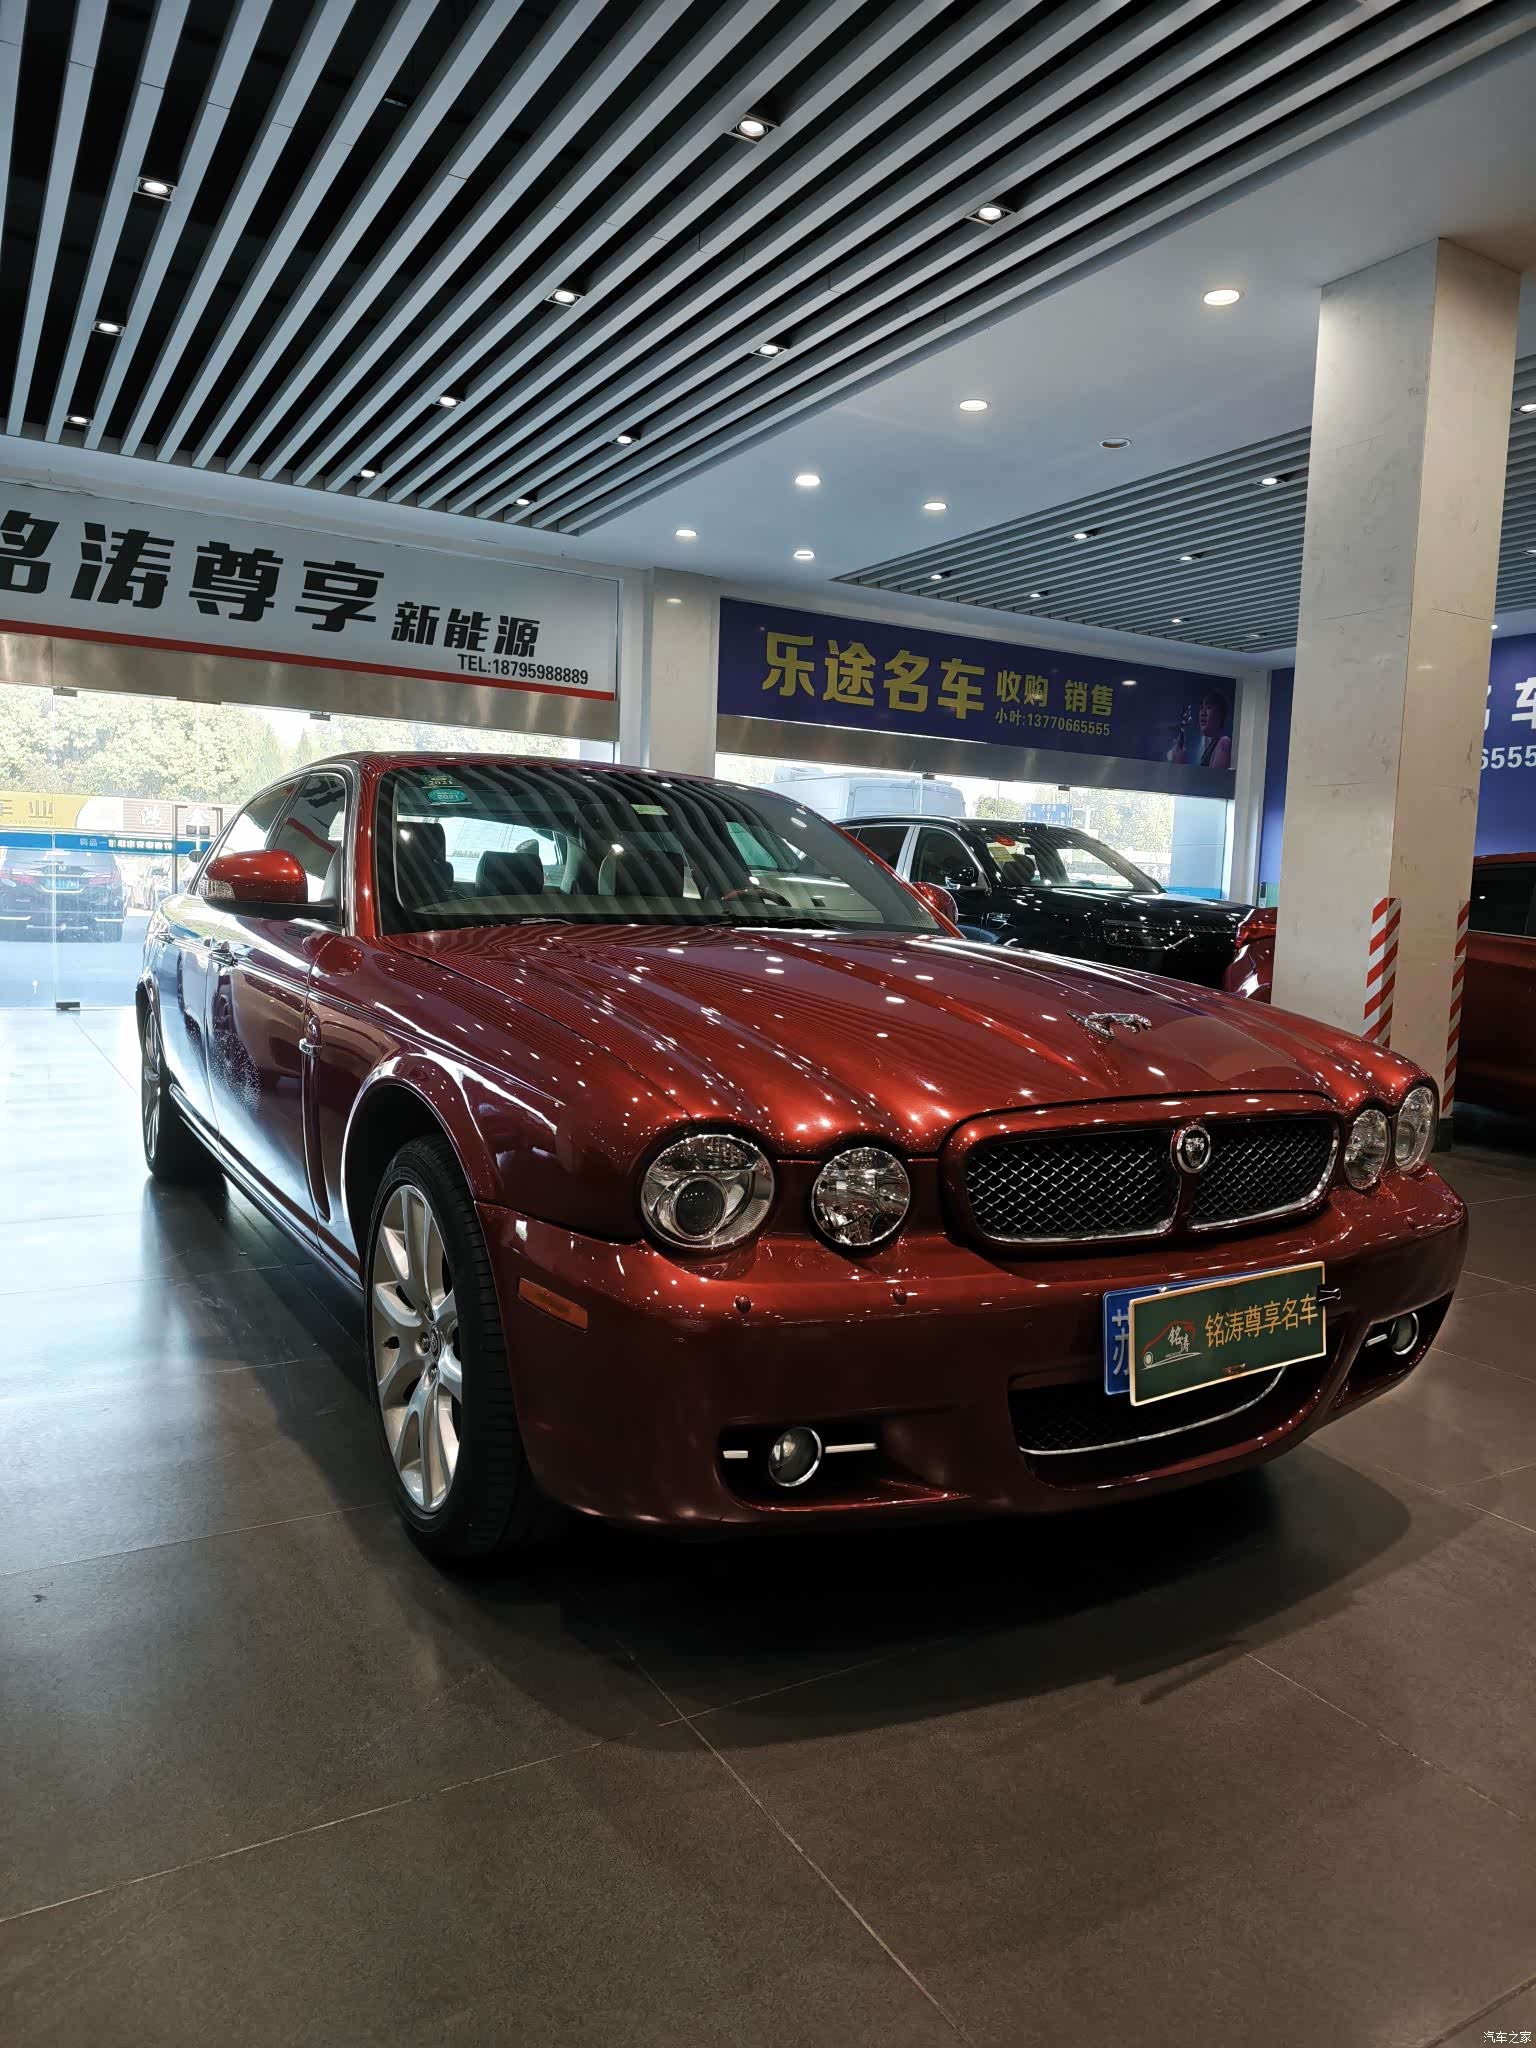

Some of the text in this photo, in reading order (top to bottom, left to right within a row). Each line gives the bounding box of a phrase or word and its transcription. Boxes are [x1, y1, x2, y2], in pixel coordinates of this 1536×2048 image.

[390, 601, 541, 658] 新能源
[457, 653, 589, 685] TEL:18795988889
[762, 631, 1114, 720] 乐途名车 收购 销售
[994, 707, 1111, 736] 小叶:13770665555
[1204, 1293, 1319, 1348] 铭涛尊享名车
